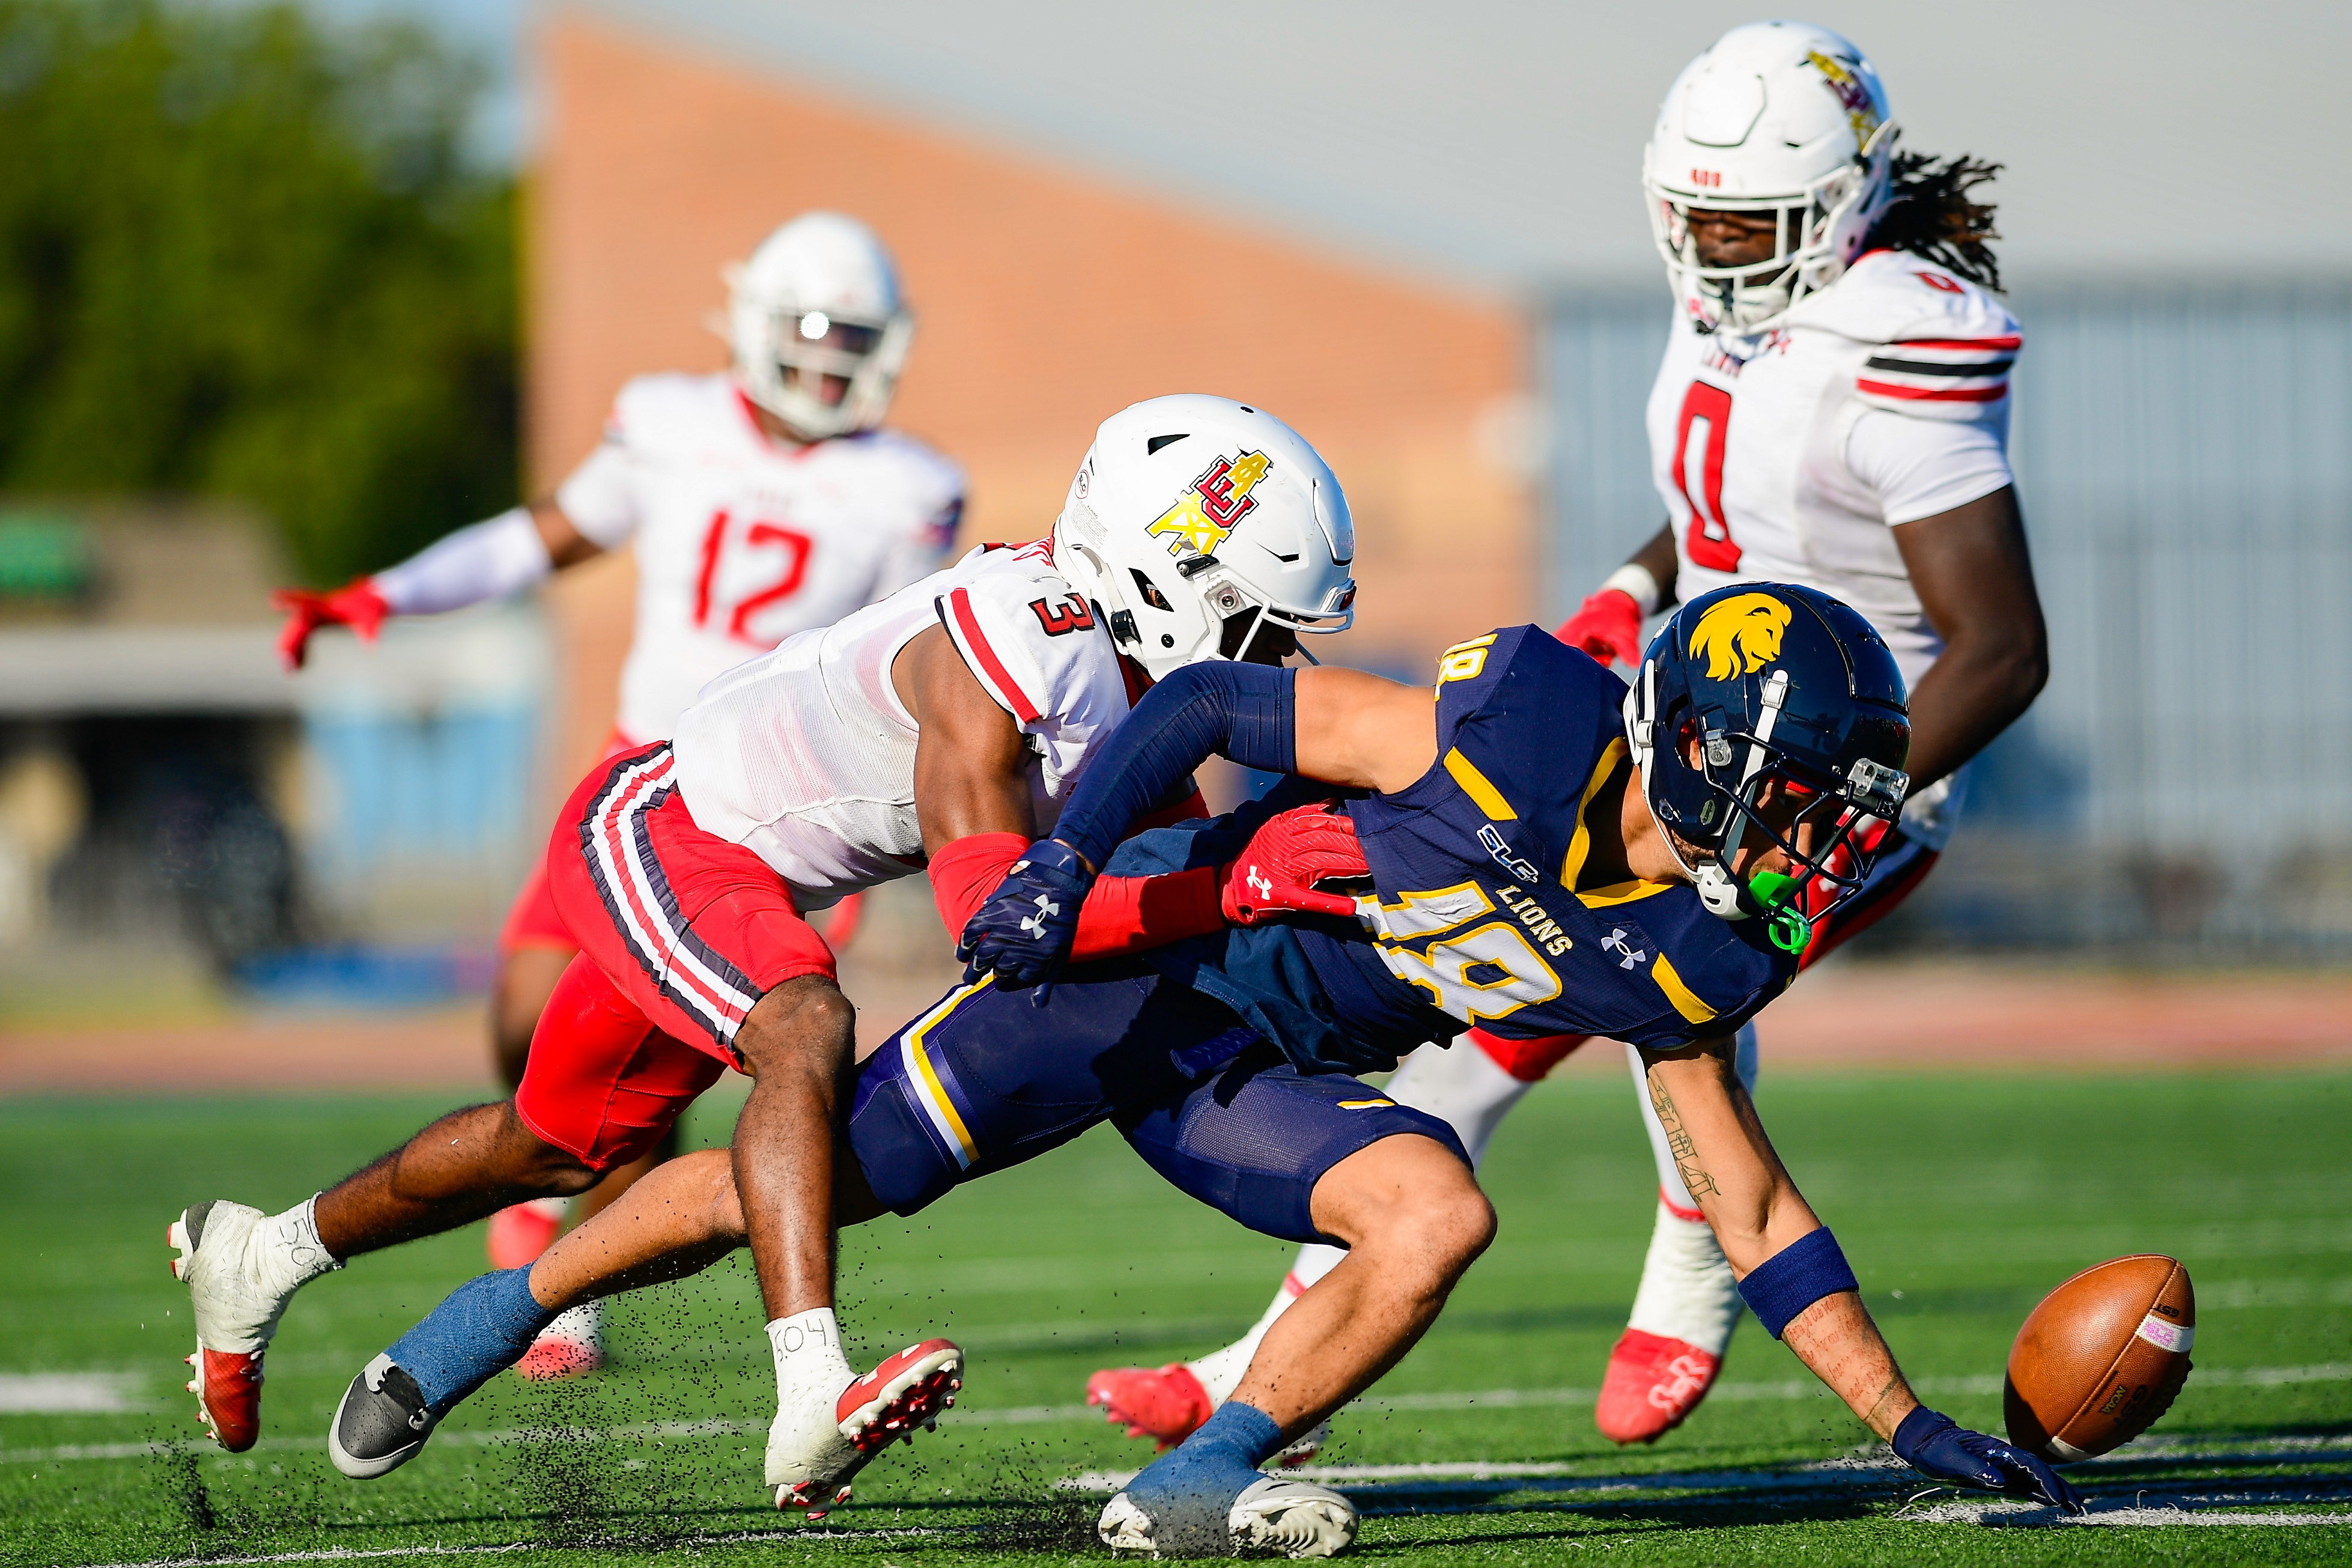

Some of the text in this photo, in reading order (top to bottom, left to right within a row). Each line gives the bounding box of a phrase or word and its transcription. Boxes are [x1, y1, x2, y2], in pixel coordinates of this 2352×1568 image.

[1672, 380, 1742, 574] 0
[692, 506, 813, 652] 12
[1028, 592, 1096, 637] 3
[1495, 884, 1573, 957] LIONS
[2102, 1385, 2127, 1414] NCAA
